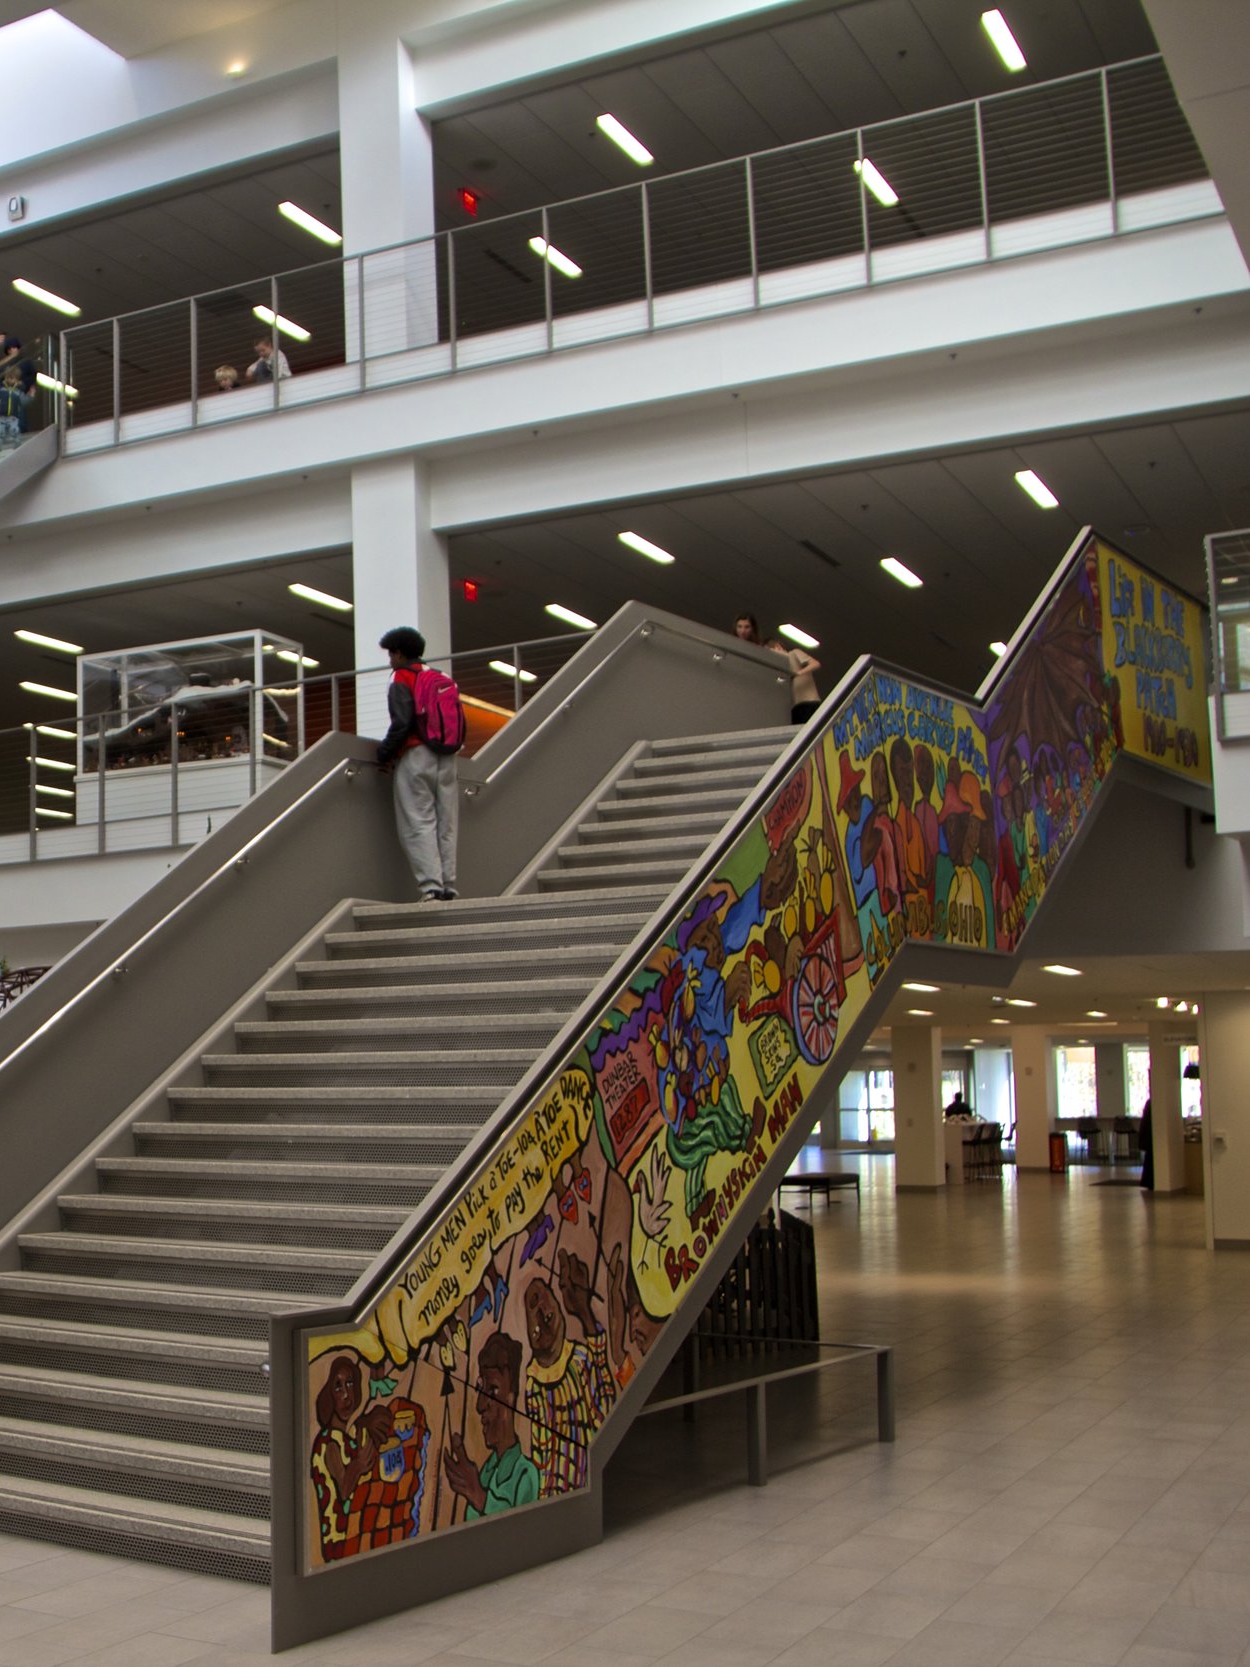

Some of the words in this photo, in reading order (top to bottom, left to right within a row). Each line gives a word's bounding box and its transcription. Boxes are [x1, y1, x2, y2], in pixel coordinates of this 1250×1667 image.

[602, 1051, 637, 1094] DUNBAR
[605, 1064, 642, 1110] THEATER
[767, 1071, 803, 1144] MAN
[540, 1119, 571, 1167] RENT
[398, 1241, 442, 1300] YOUNG
[440, 1207, 466, 1253] MEN
